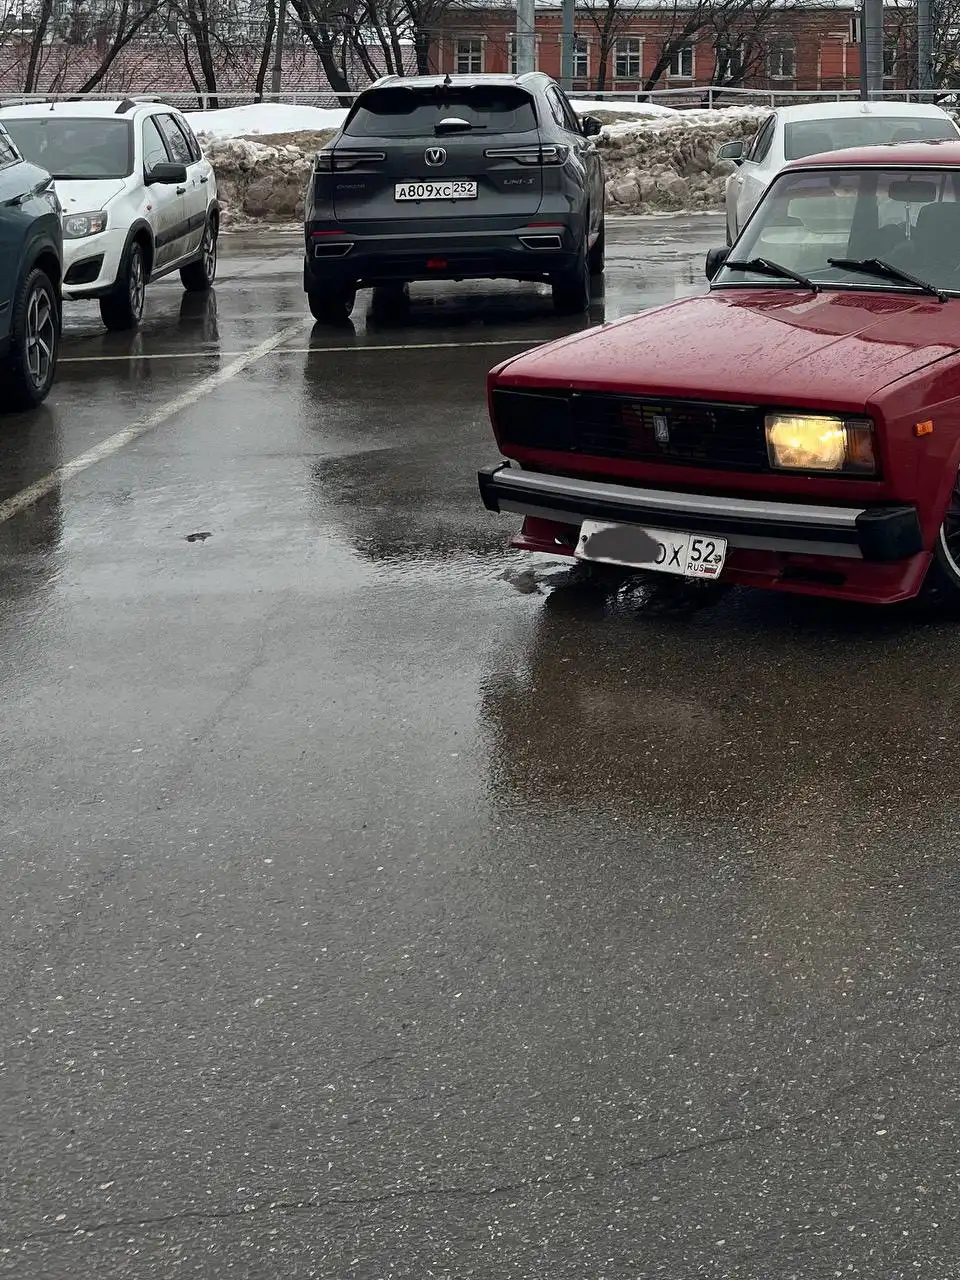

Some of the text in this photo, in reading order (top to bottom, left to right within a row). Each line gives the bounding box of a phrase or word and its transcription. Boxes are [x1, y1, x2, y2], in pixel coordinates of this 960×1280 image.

[453, 183, 474, 193] 252
[690, 539, 716, 563] 52
[687, 562, 704, 572] RUS
